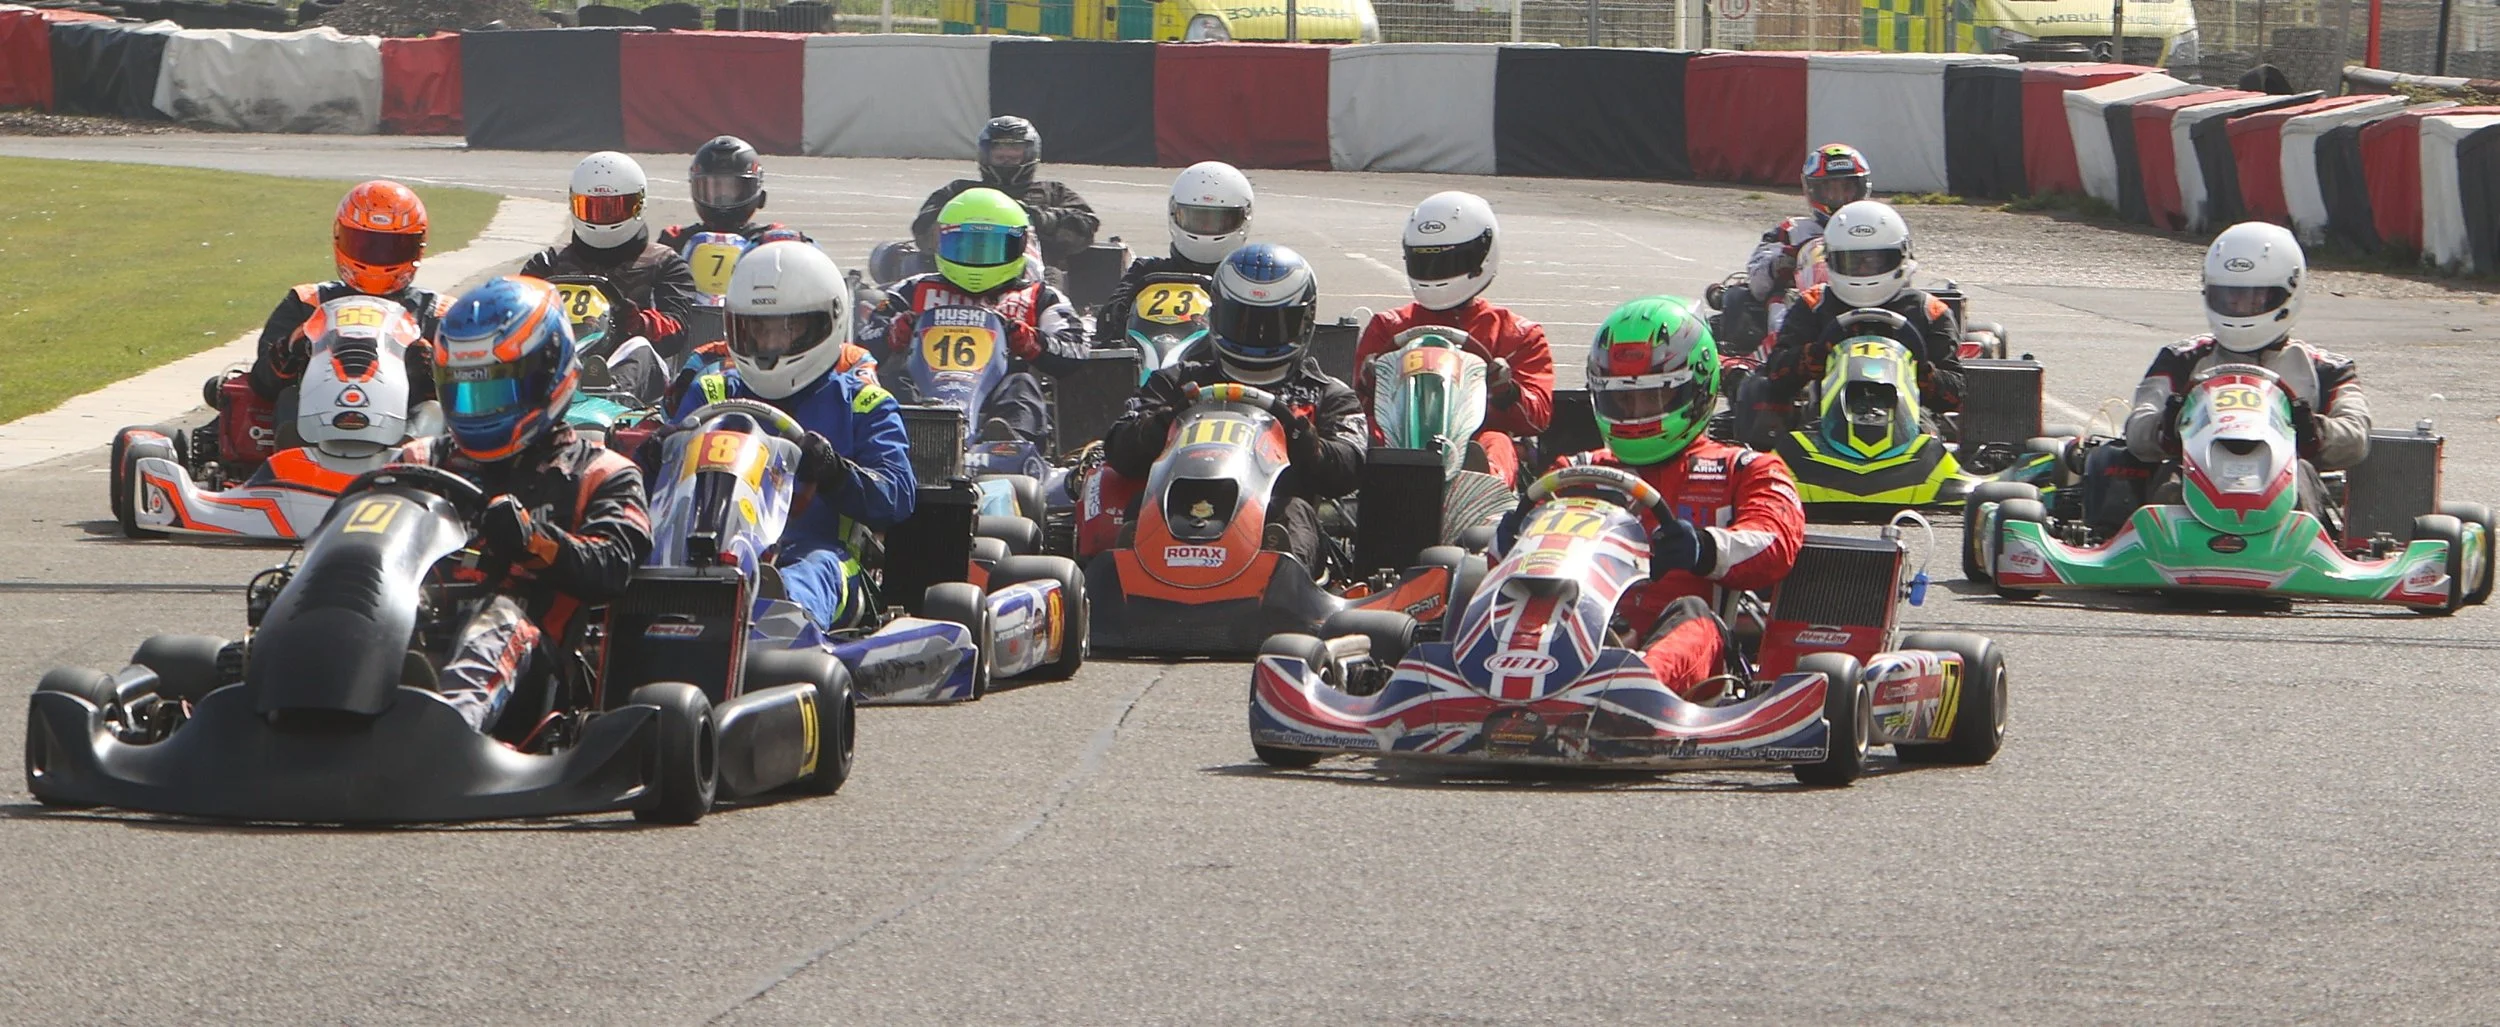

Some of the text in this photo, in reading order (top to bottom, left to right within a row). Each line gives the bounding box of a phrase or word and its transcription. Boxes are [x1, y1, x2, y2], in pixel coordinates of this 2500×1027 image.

[1147, 289, 1194, 316] 23
[336, 306, 383, 327] 55
[933, 307, 987, 323] HUSKI
[932, 335, 976, 367] 16
[2215, 389, 2263, 409] 50
[1186, 420, 1254, 446] 116
[707, 434, 740, 464] 8
[1692, 465, 1724, 474] ARMY
[1543, 511, 1602, 533] 17
[1167, 547, 1222, 559] ROTAX
[1049, 589, 1065, 654] 8
[1931, 663, 1960, 737] 17
[1304, 733, 1379, 748] Developmen
